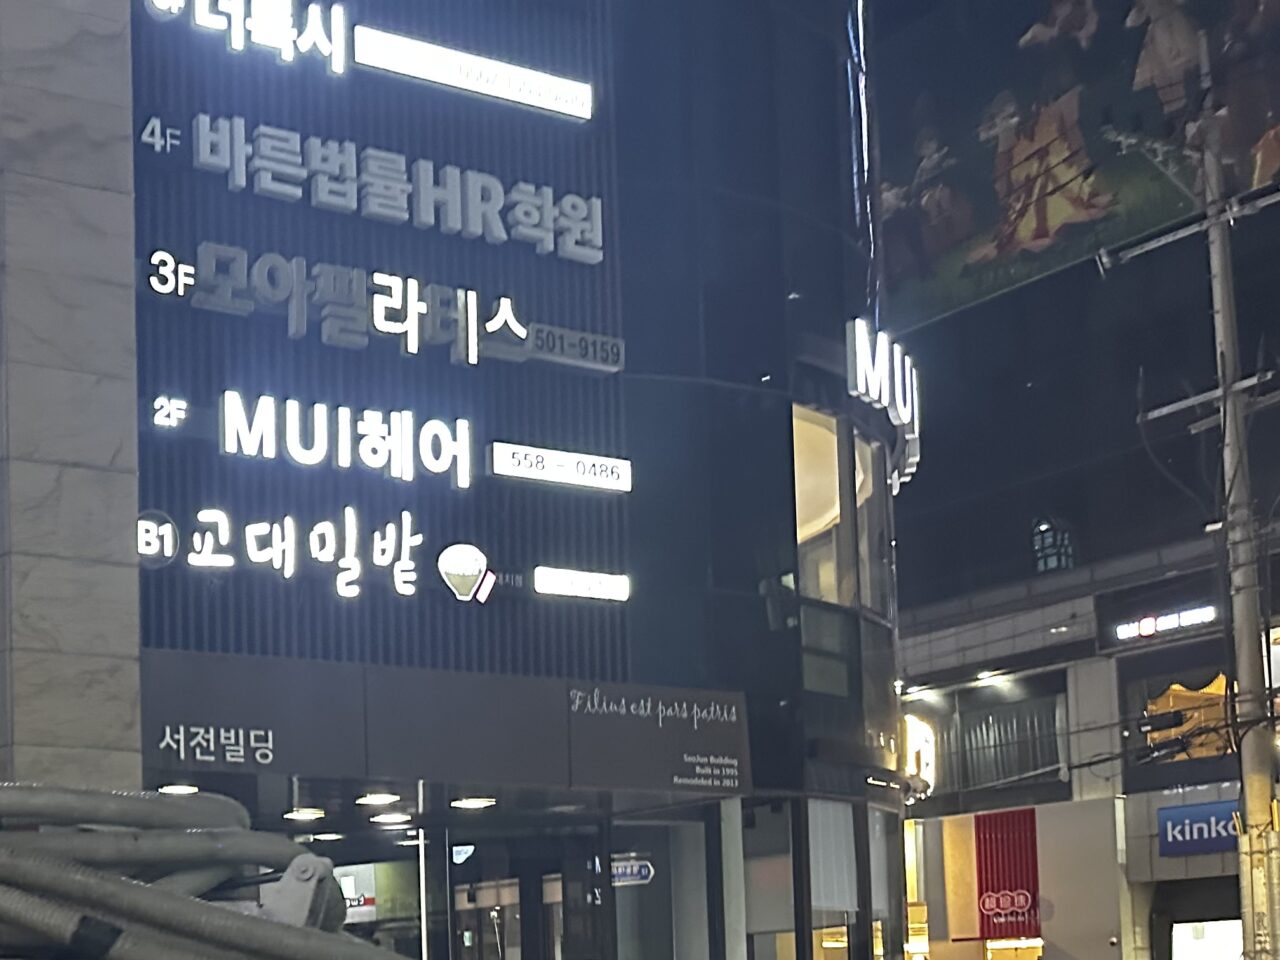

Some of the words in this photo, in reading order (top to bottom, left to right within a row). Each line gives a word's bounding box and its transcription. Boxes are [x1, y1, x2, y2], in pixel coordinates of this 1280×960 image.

[141, 116, 181, 153] 4F
[192, 112, 604, 265] 바른법률HR학원
[149, 250, 195, 297] 3F
[533, 327, 620, 364] 501-9159
[153, 397, 187, 427] 2F
[223, 390, 471, 488] MUI헤어
[137, 520, 173, 556] B1
[187, 506, 423, 597] 교대밀밭
[630, 697, 653, 718] est
[656, 700, 688, 728] pars
[693, 701, 738, 730] patris
[159, 724, 274, 764] 서전빌딩
